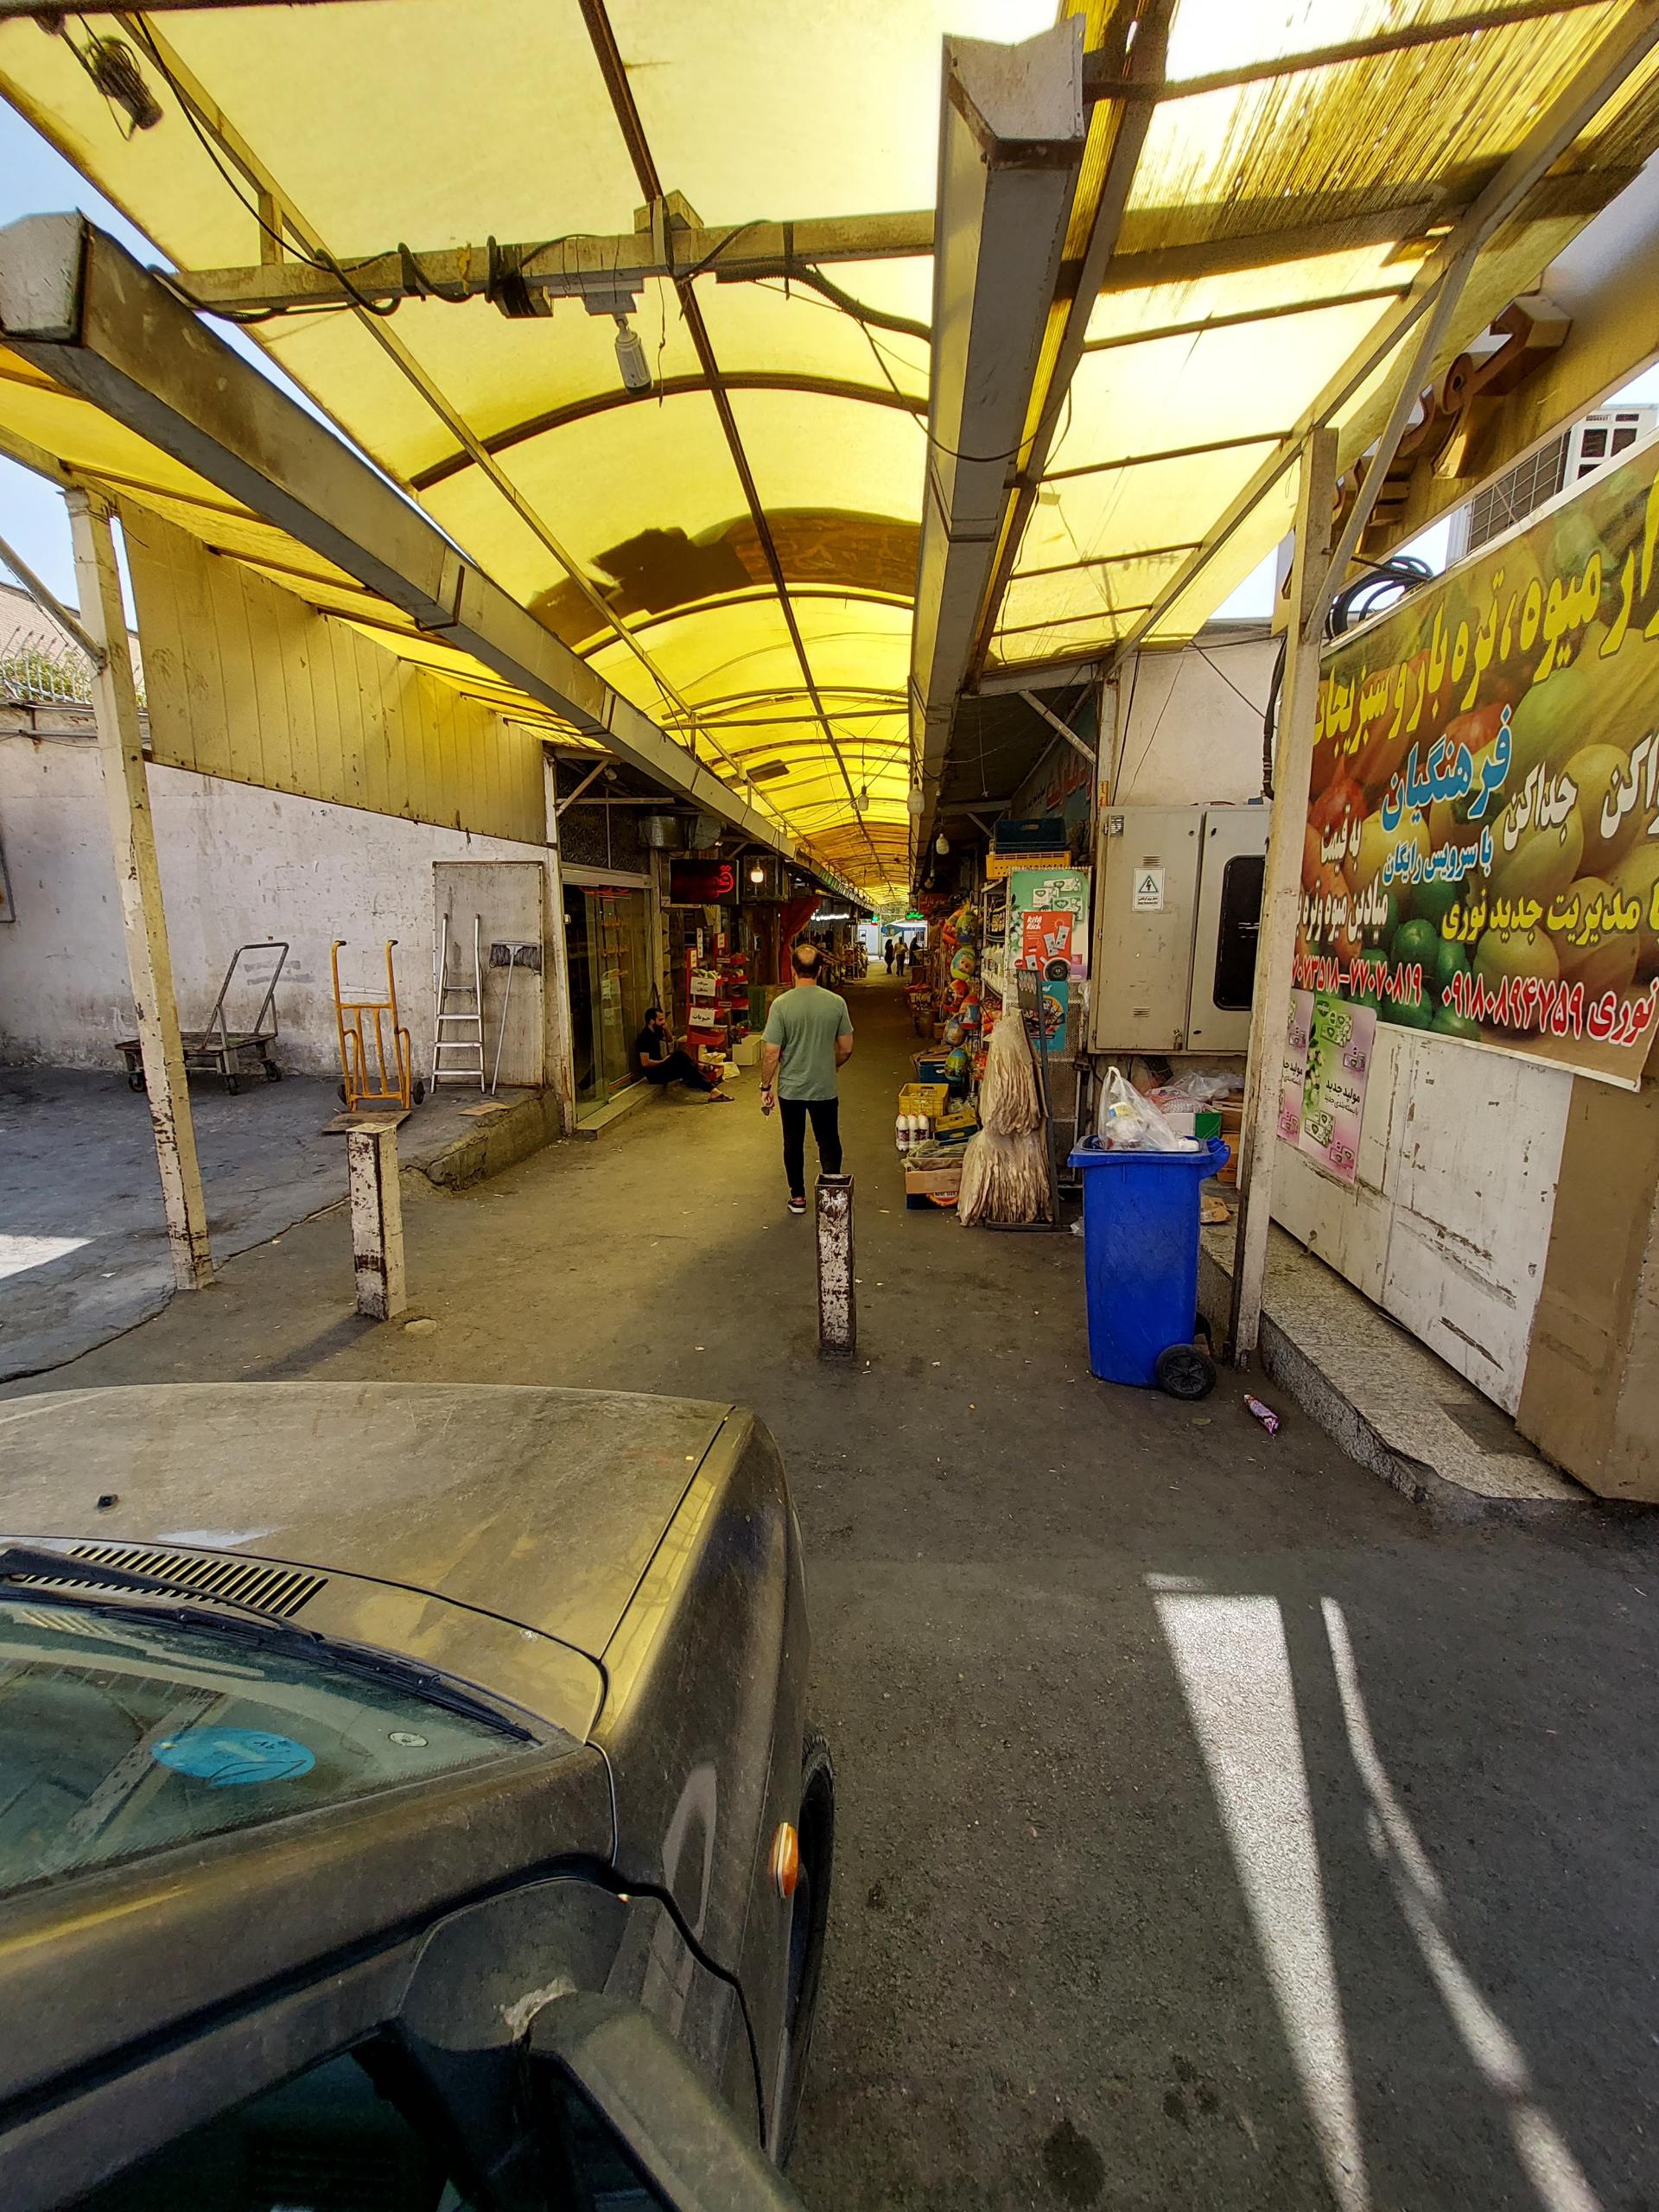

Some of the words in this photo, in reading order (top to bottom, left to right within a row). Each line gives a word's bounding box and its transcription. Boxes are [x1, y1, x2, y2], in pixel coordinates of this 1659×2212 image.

[1382, 703, 1512, 832] فرهنگیان
[1321, 804, 1351, 874] قیمت
[1382, 836, 1423, 887] رایگان
[1423, 841, 1478, 883] سرویس
[1479, 824, 1494, 879] با
[1325, 893, 1348, 942] میوه
[1347, 869, 1389, 944] میادین
[1442, 887, 1487, 941] نوری
[1490, 894, 1545, 944] جدید
[1548, 889, 1642, 945] مدیریت
[1441, 969, 1585, 1040] ۰۹۱۸۰۸۹۴۷۵۹
[1586, 976, 1659, 1047] نوری
